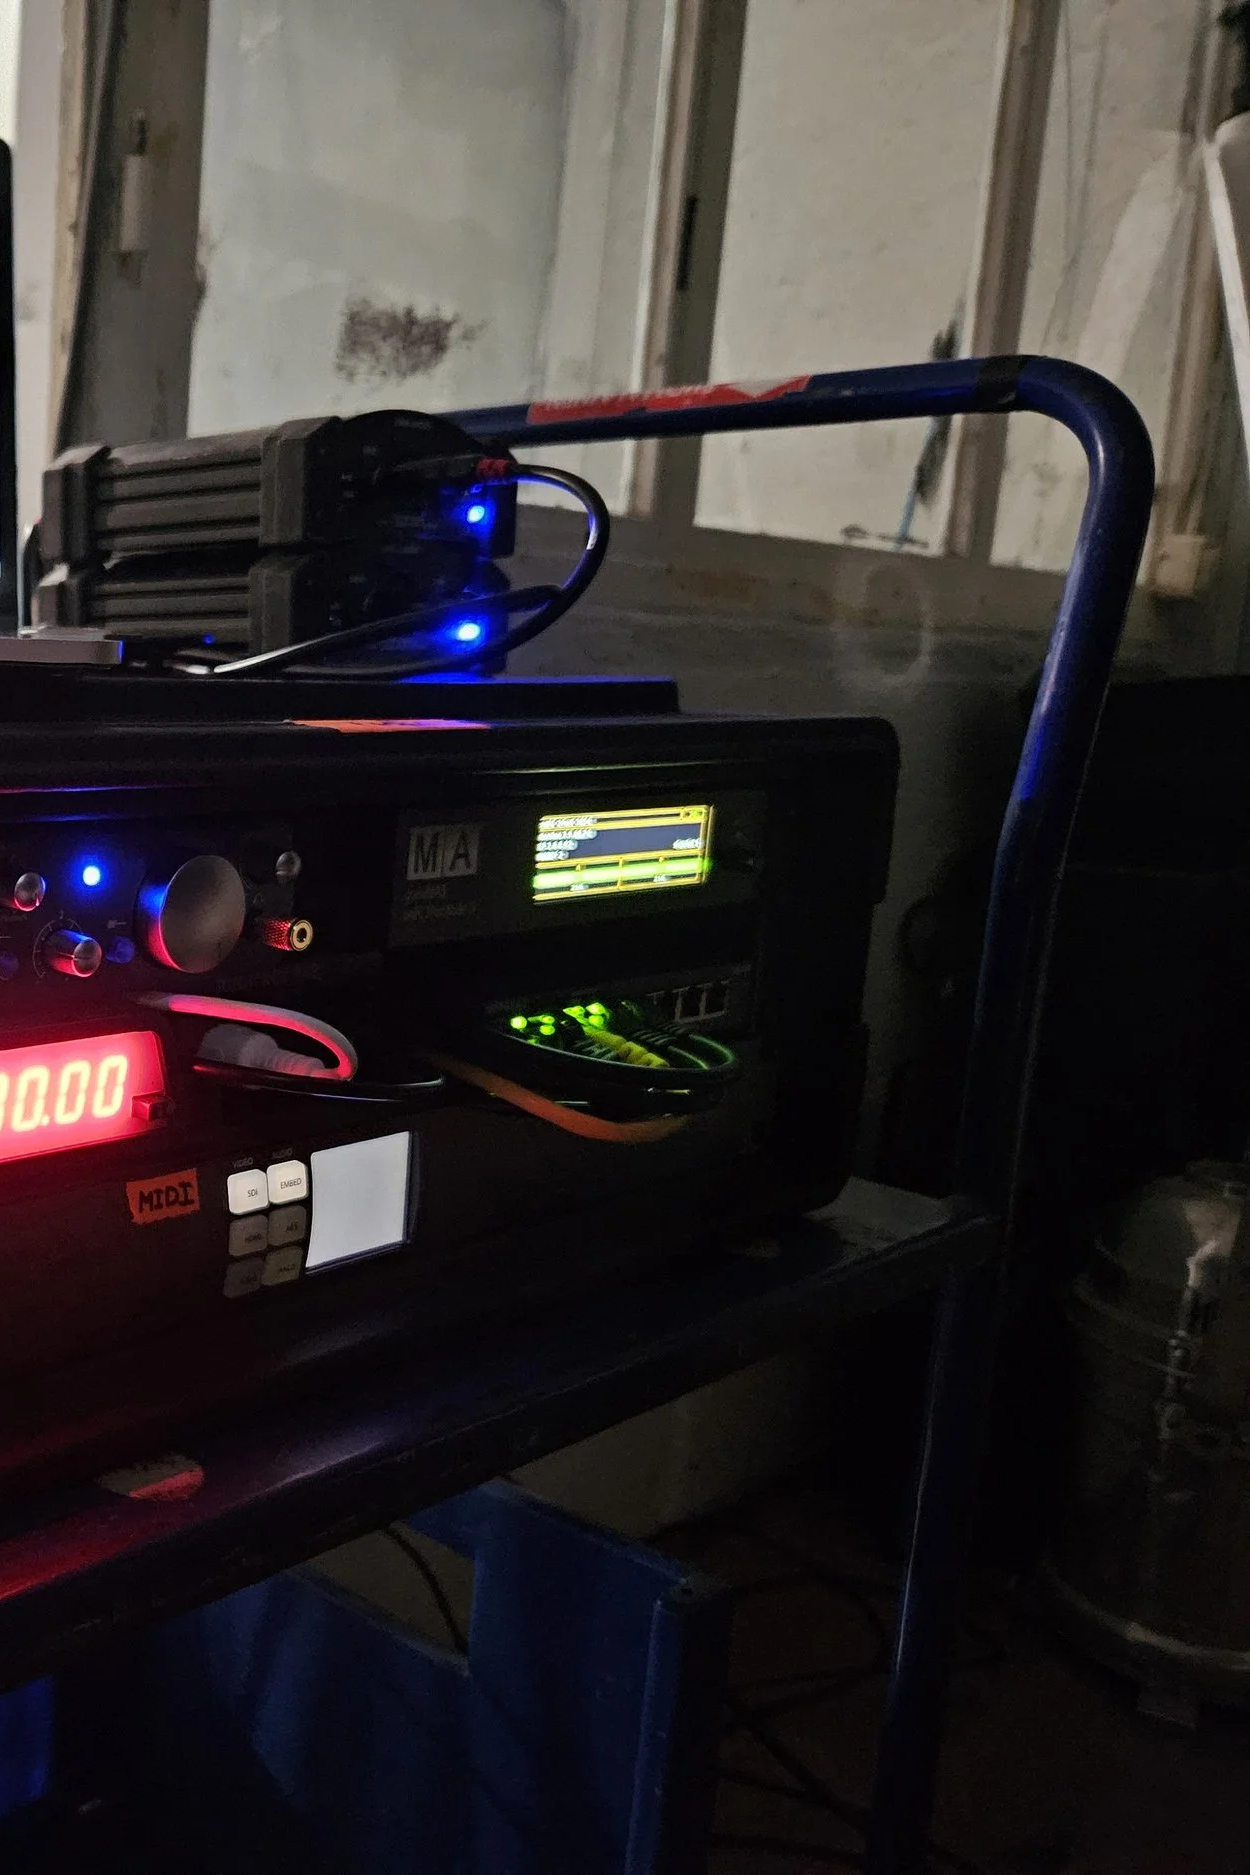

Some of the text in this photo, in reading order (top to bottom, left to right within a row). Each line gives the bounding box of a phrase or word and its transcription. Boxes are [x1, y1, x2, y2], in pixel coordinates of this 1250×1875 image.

[280, 1177, 302, 1190] EMBED
[138, 1180, 196, 1213] MIDI
[247, 1187, 258, 1198] SDI
